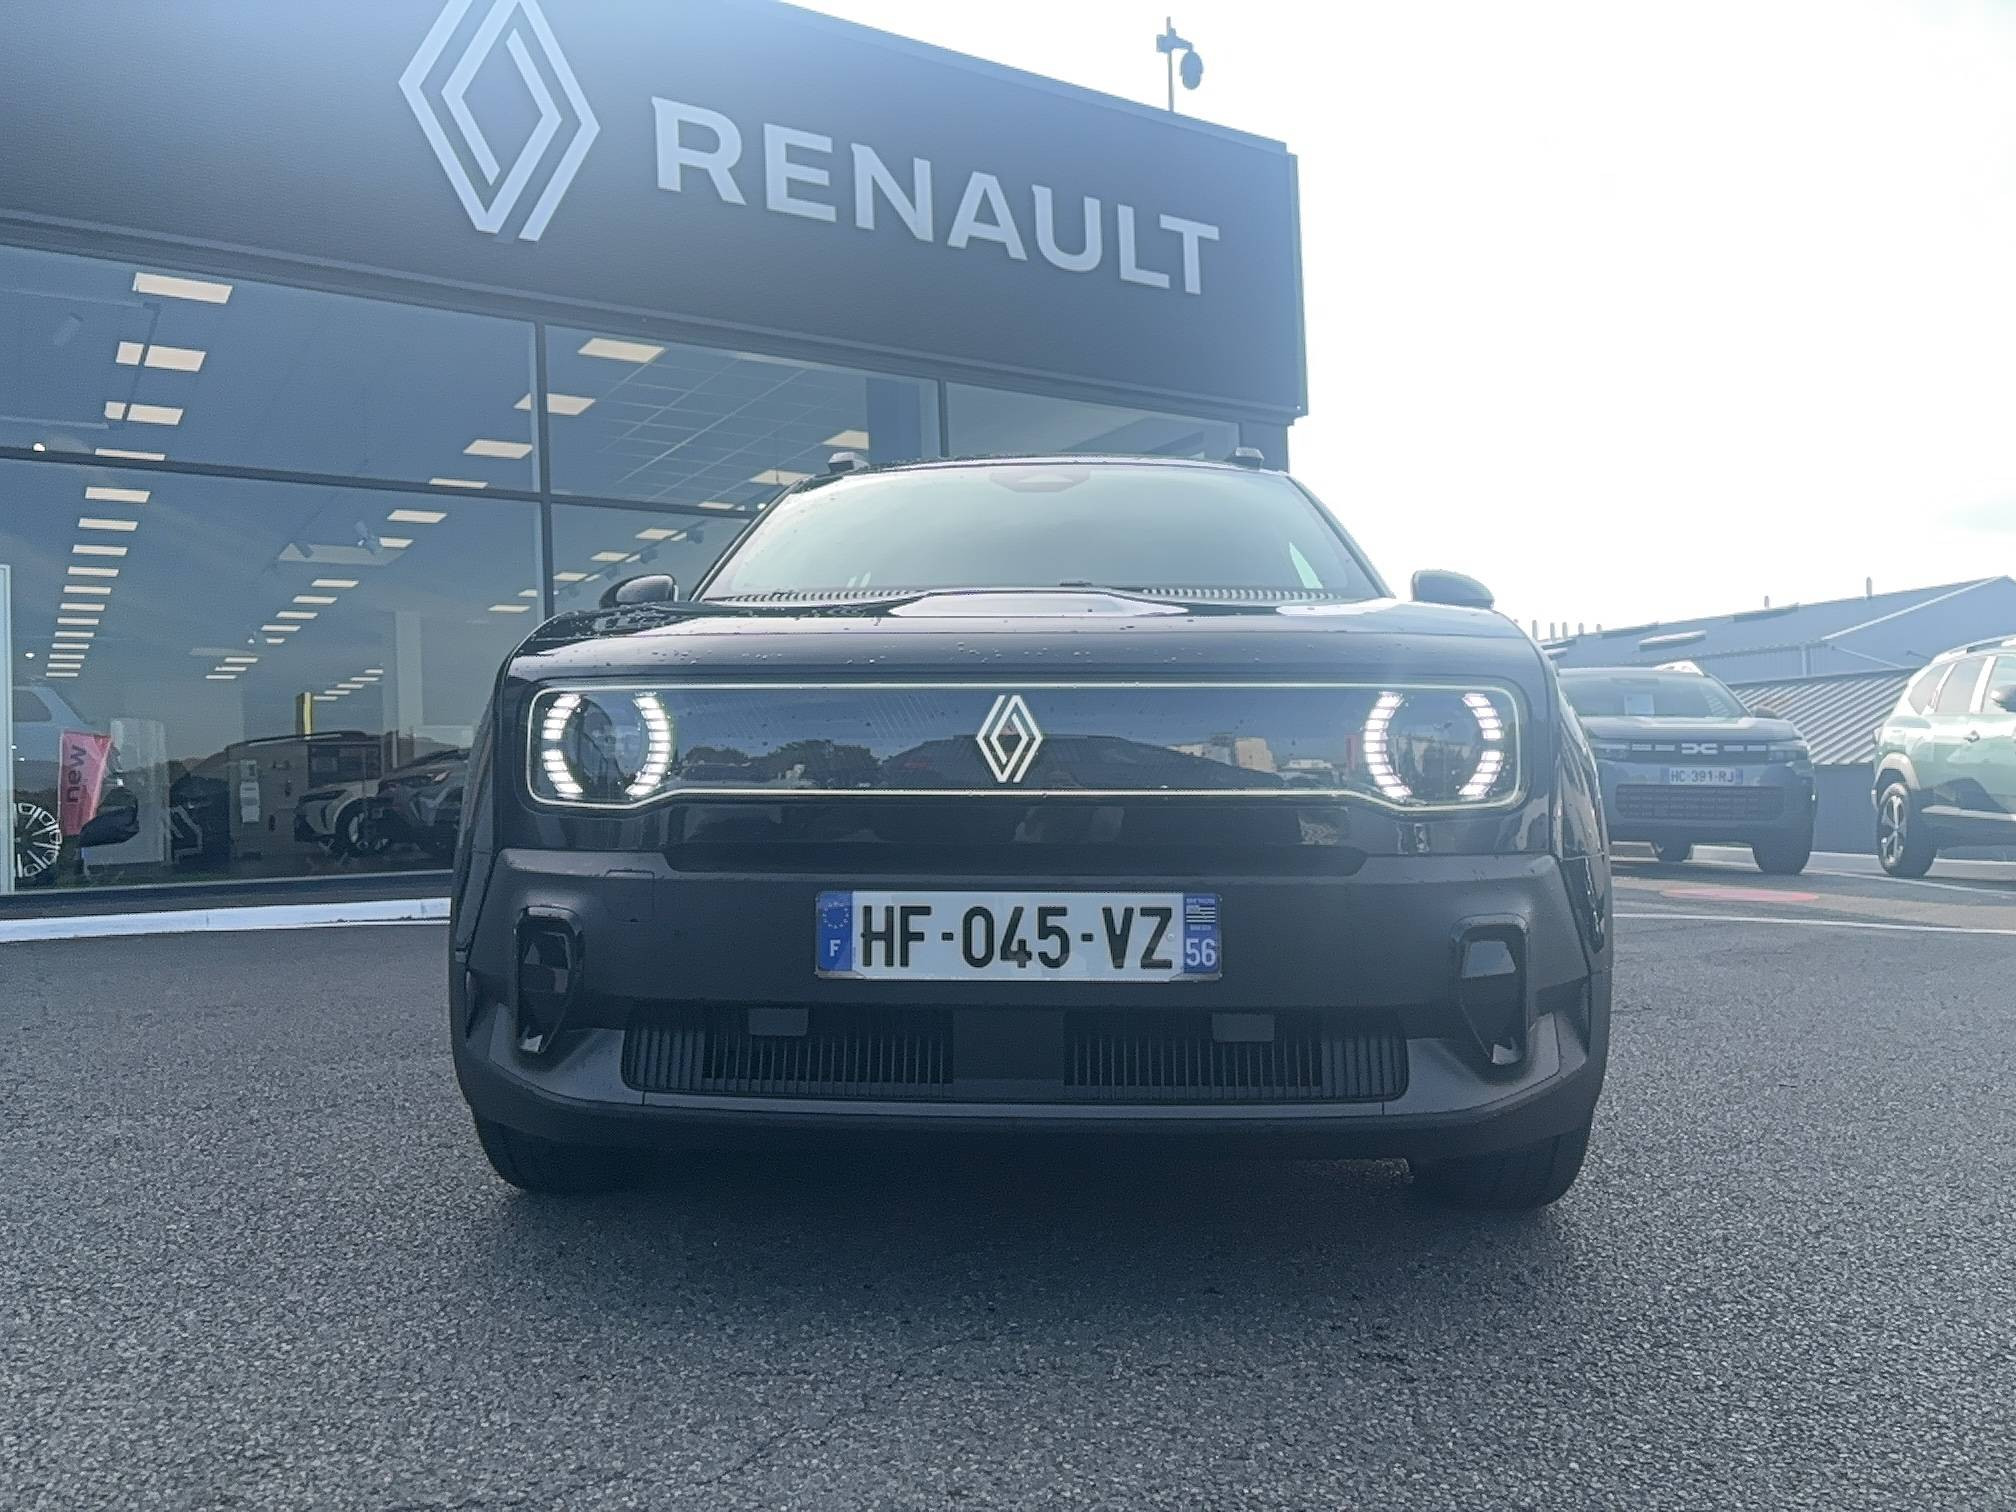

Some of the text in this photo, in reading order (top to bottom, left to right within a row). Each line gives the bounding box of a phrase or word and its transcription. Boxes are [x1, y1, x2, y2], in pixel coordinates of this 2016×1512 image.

[651, 95, 1219, 295] RENAULT
[65, 744, 87, 804] new
[1670, 769, 1735, 783] HC-391-RJ
[829, 939, 841, 957] F
[861, 904, 1174, 970] HF-045-VZ
[1186, 938, 1216, 967] 56
